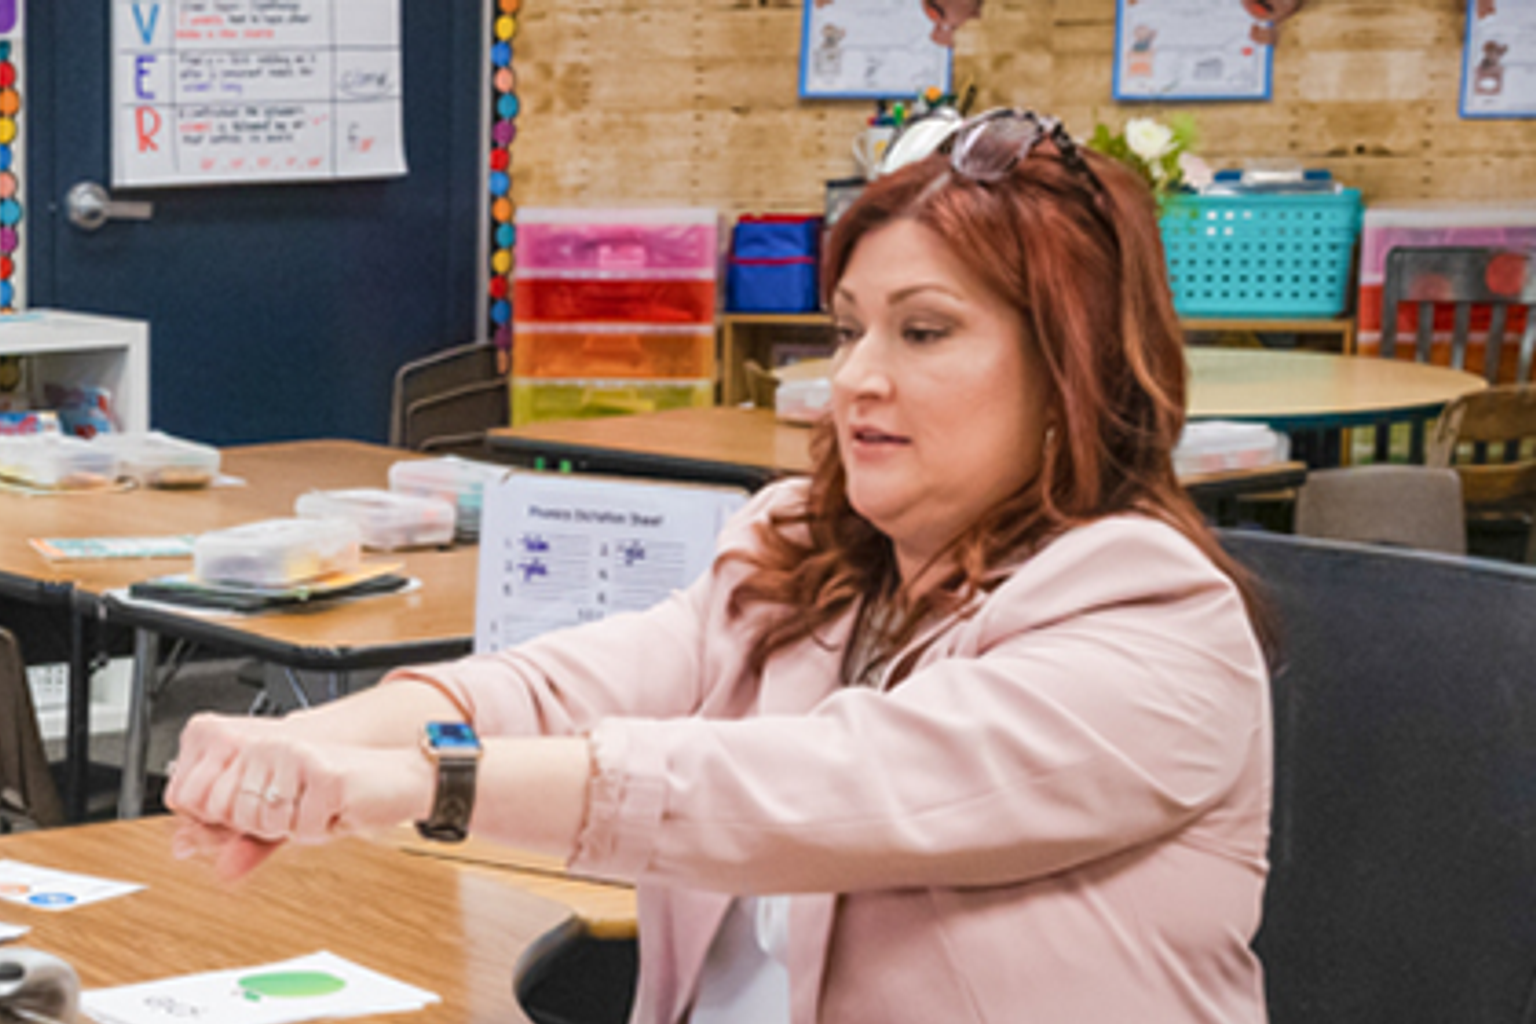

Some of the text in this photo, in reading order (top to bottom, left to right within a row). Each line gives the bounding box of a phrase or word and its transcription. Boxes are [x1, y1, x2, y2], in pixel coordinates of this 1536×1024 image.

[132, 3, 159, 45] V
[134, 55, 158, 100] E
[134, 105, 163, 152] R
